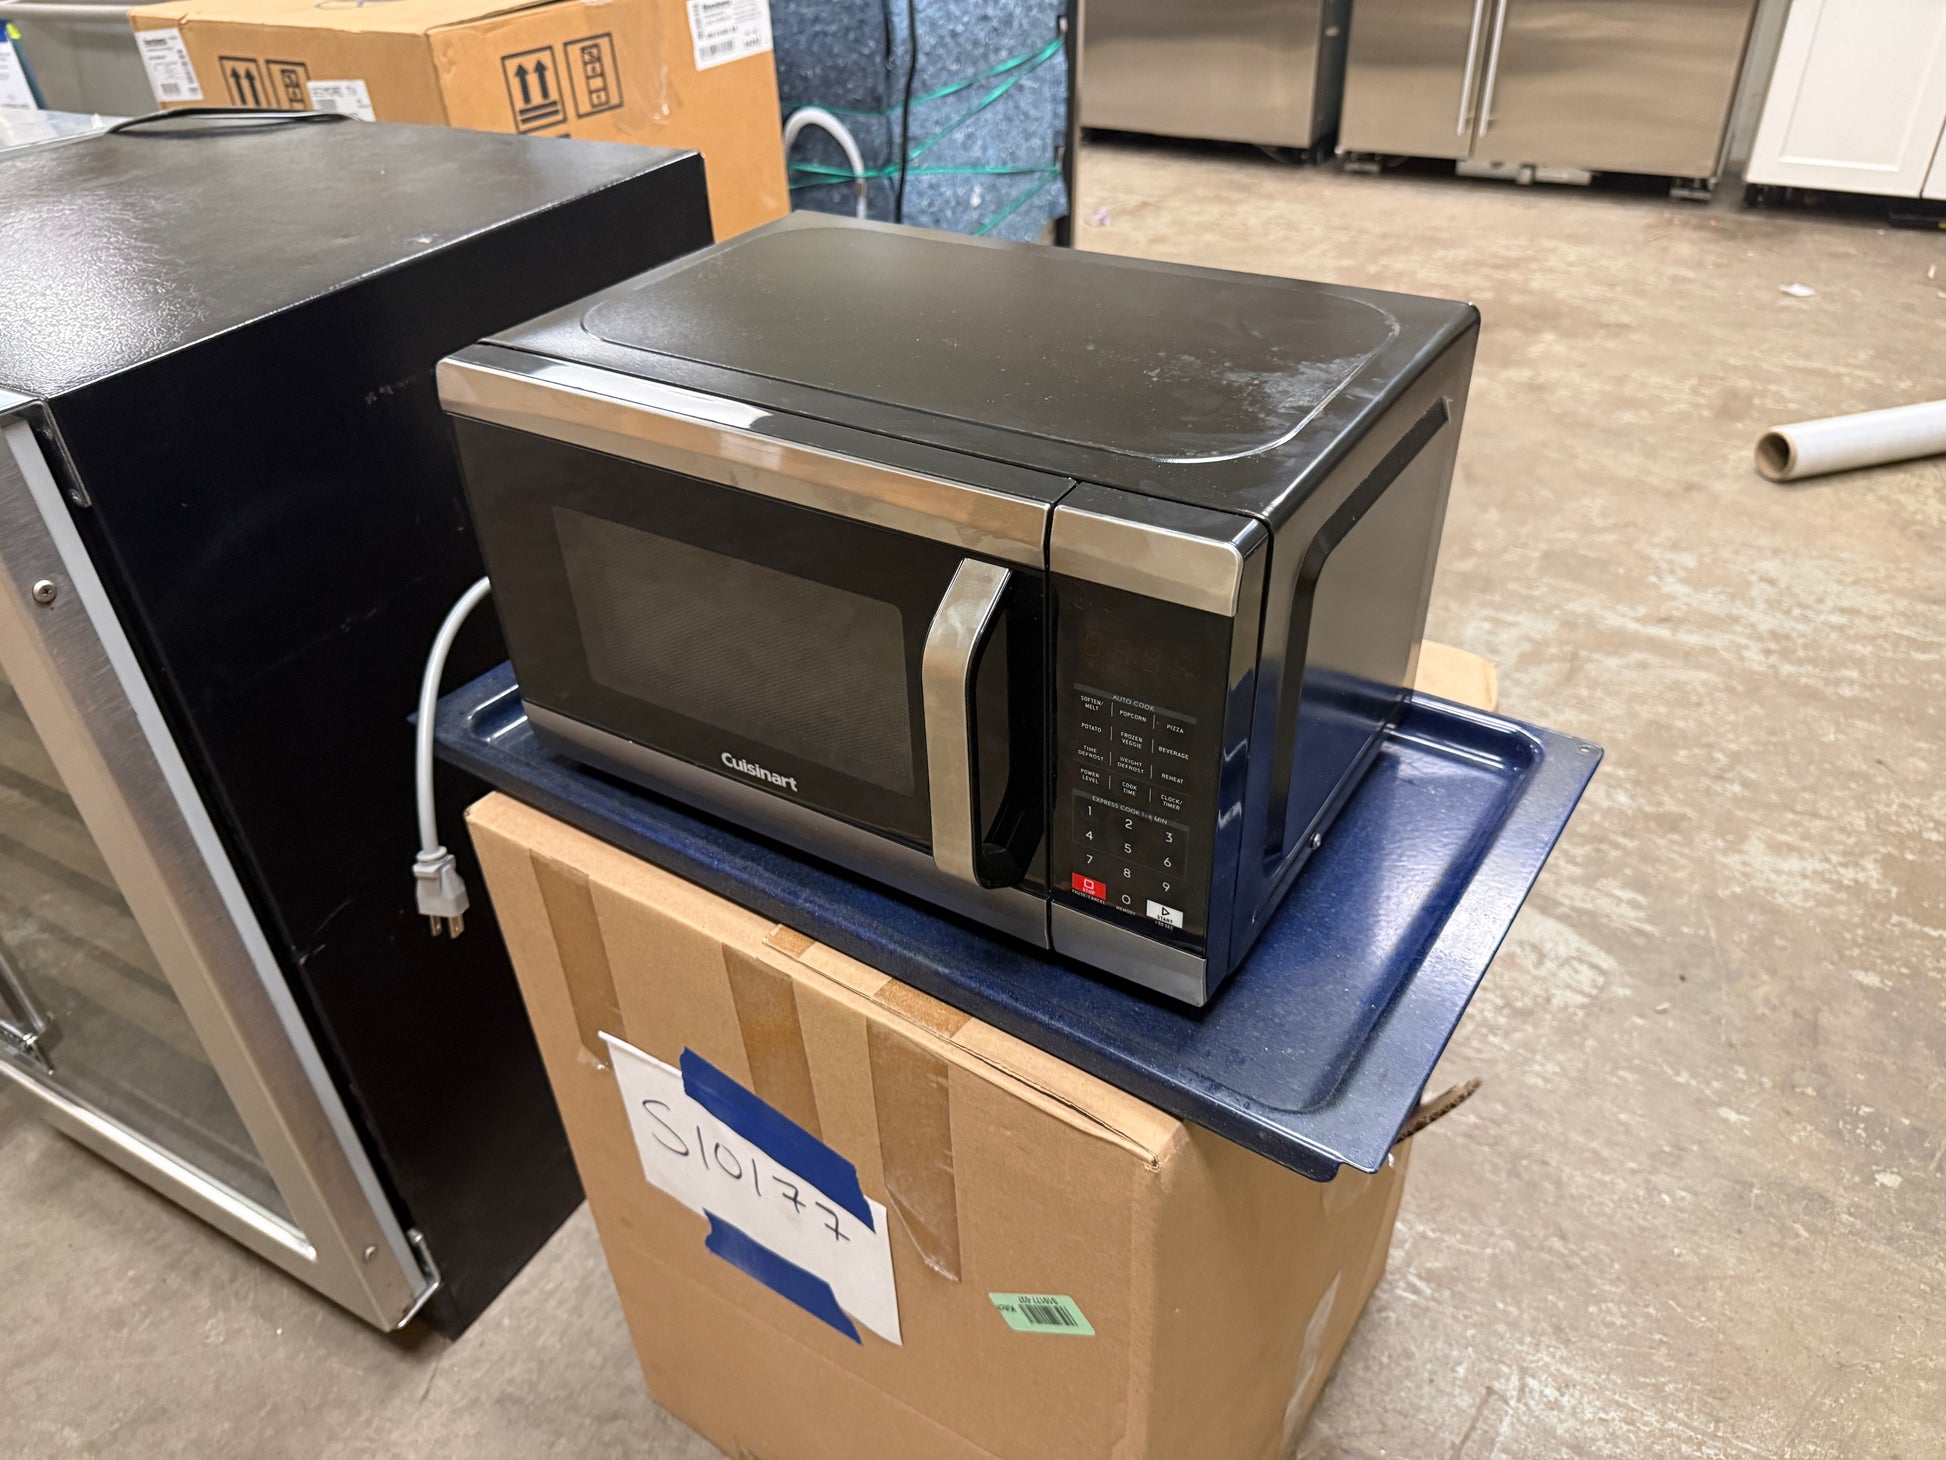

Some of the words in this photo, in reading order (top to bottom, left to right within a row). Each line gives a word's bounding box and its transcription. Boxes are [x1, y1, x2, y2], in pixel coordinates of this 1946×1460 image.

[1080, 695, 1104, 706] SOFTEN/
[1112, 694, 1132, 705] AUTO
[1133, 700, 1155, 712] COOK
[1084, 703, 1099, 711] MELT
[1119, 709, 1147, 722] POPCORN
[1081, 722, 1102, 733] POTATO
[1166, 724, 1184, 734] PIZZA
[1120, 731, 1143, 742] FROZEN
[1083, 744, 1097, 753] TIME
[1121, 738, 1142, 749] VEGGIE
[1078, 750, 1104, 762] DEFROST
[1158, 746, 1189, 760] BEVERAGE
[1119, 756, 1142, 767] WEIGHT
[721, 752, 798, 792] Cuisinart
[1080, 768, 1100, 778] POWER
[1117, 762, 1144, 774] DEFROST
[1082, 775, 1099, 784] LEVEL
[1161, 773, 1184, 784] REHEAT
[1122, 782, 1138, 790] COOK
[1123, 788, 1136, 796] TIME
[1160, 794, 1183, 805] CLOCK/
[1087, 805, 1092, 816] 1
[1092, 795, 1119, 808] EXPRESS
[1120, 805, 1140, 816] COOK
[1154, 816, 1168, 825] MIN
[1162, 801, 1181, 811] TIMER
[1125, 818, 1133, 830] 2
[1085, 830, 1094, 840] 4
[1165, 831, 1173, 843] 3
[1124, 843, 1132, 854] 5
[1086, 854, 1094, 864] 7
[1163, 857, 1172, 868] 6
[1123, 867, 1131, 878] 8
[1162, 882, 1170, 892] 9
[1157, 914, 1173, 924] START
[641, 1099, 851, 1242] S10177
